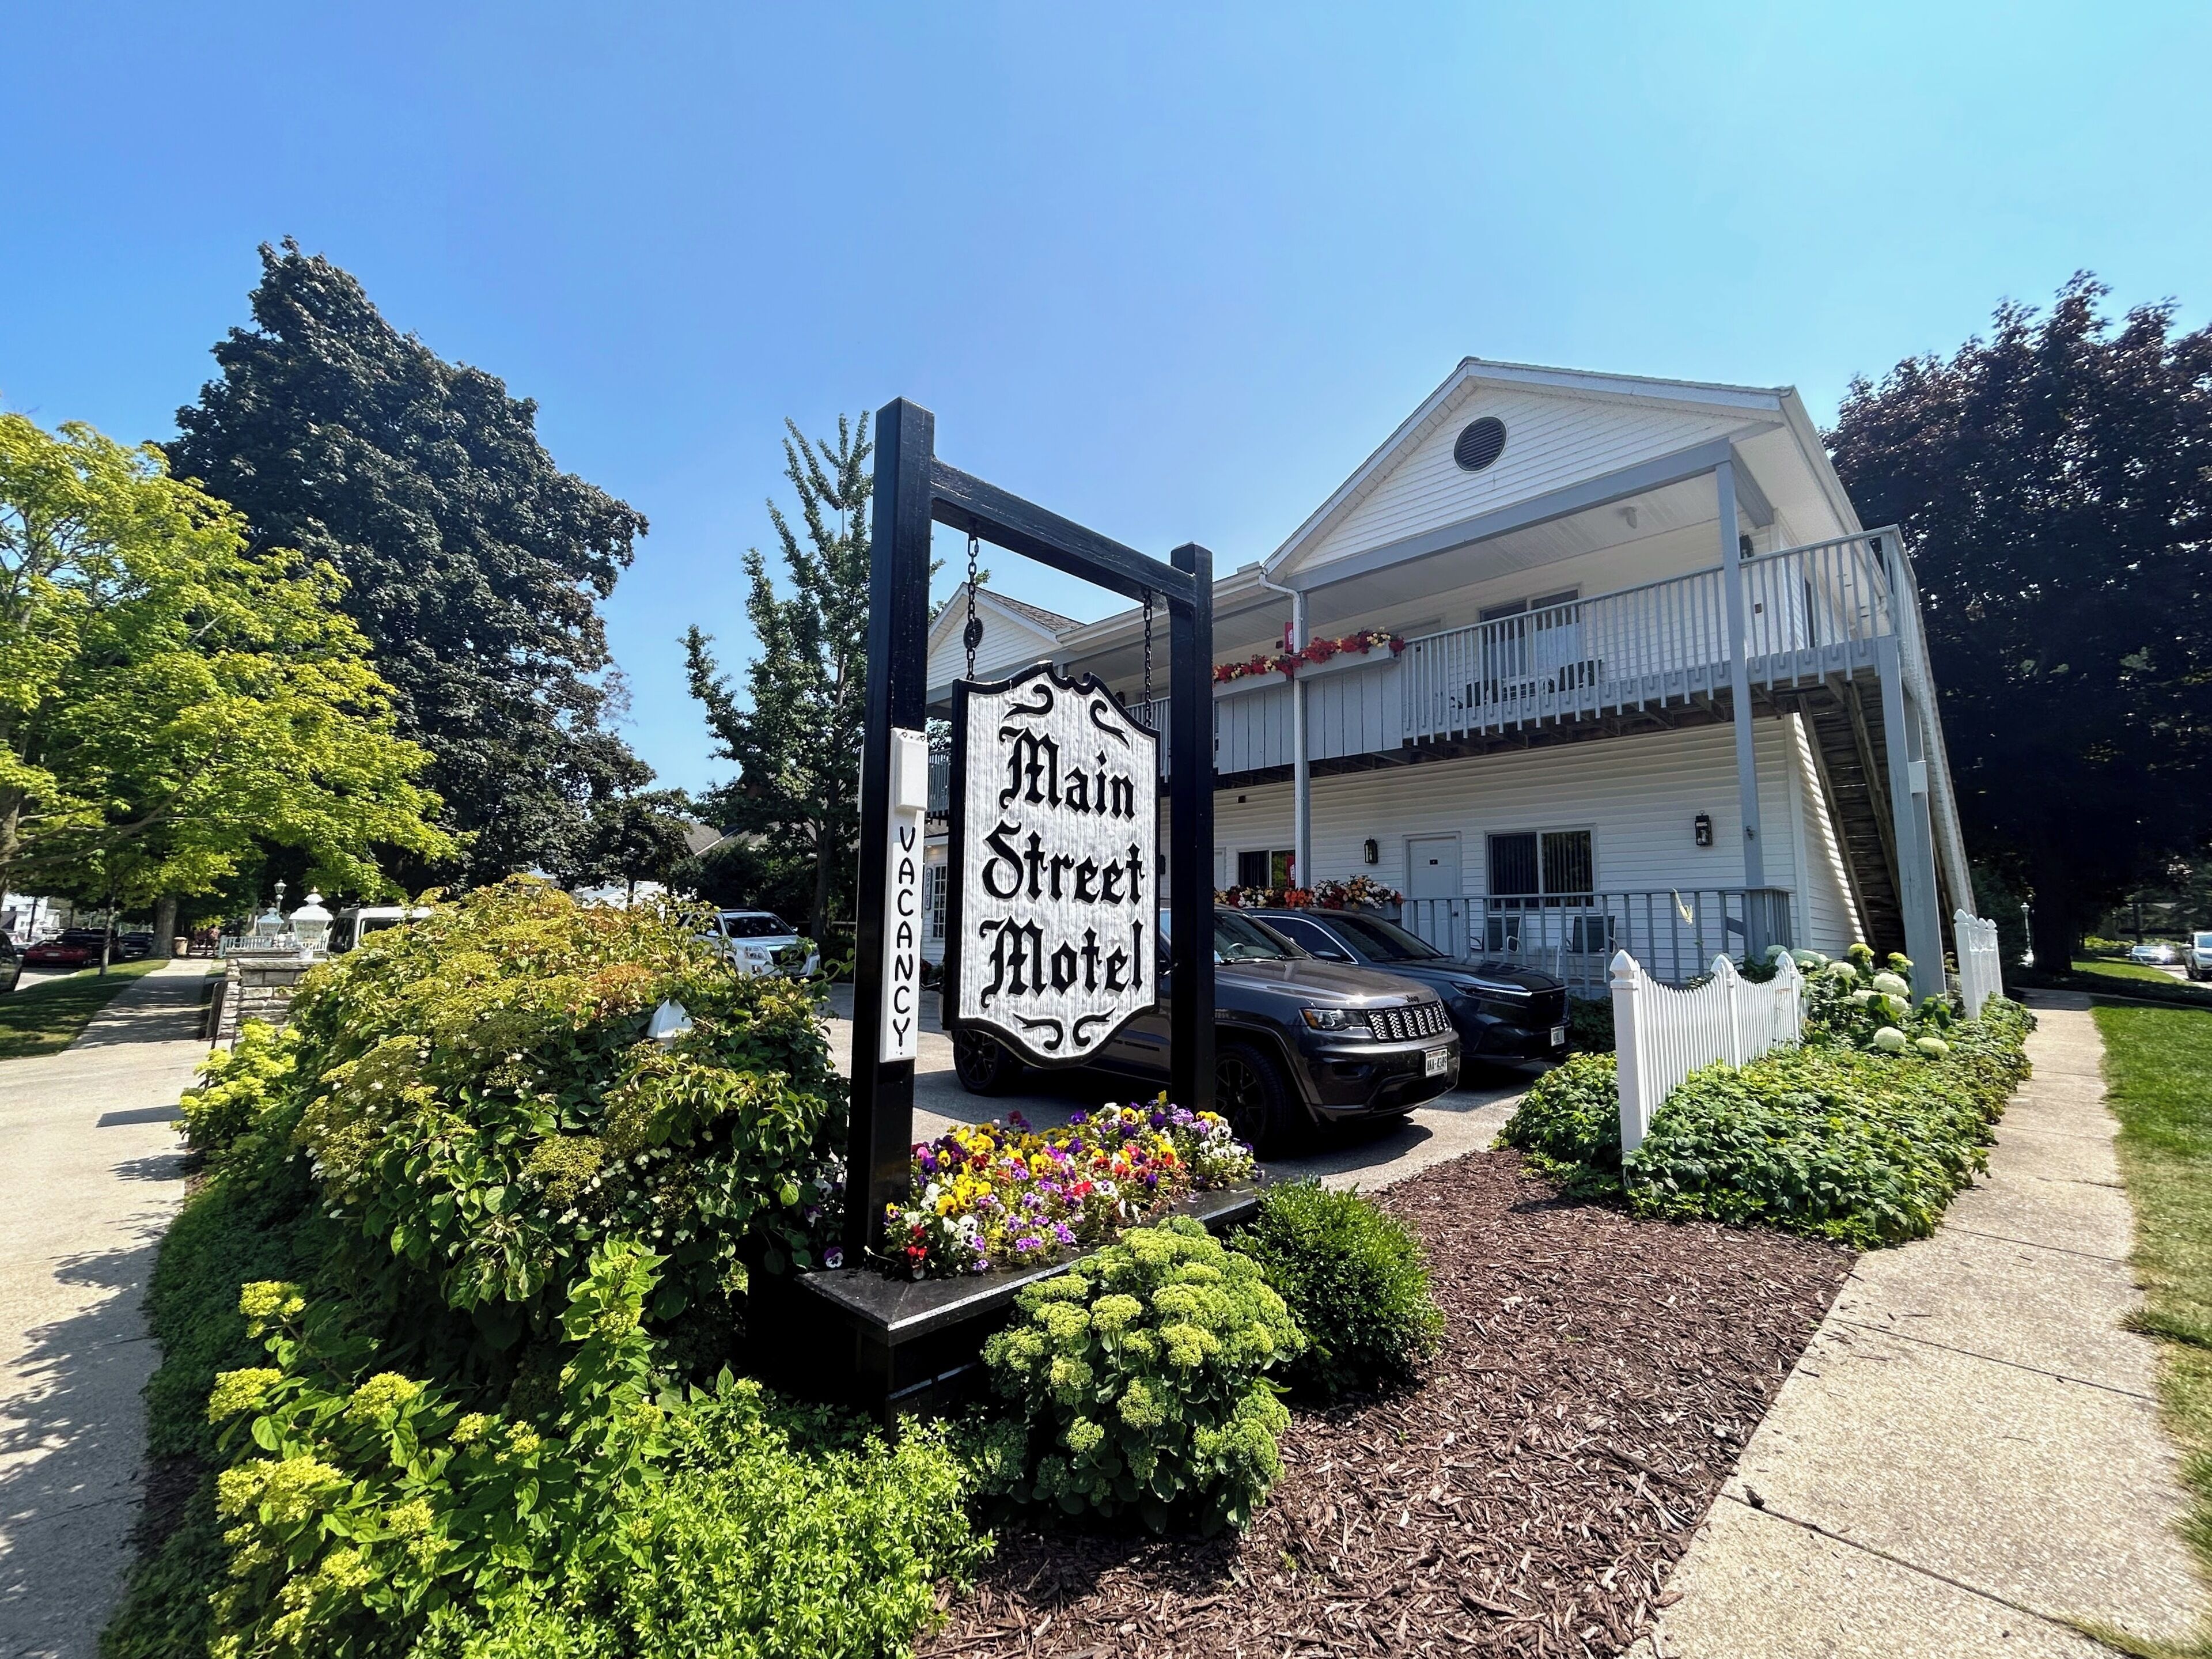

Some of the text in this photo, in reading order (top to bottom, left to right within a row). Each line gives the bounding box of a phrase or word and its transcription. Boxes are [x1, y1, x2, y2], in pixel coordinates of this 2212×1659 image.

[998, 726, 1135, 820] Main
[982, 819, 1145, 906] Street
[893, 826, 916, 1047] VACANCY
[979, 915, 1143, 1009] Motel
